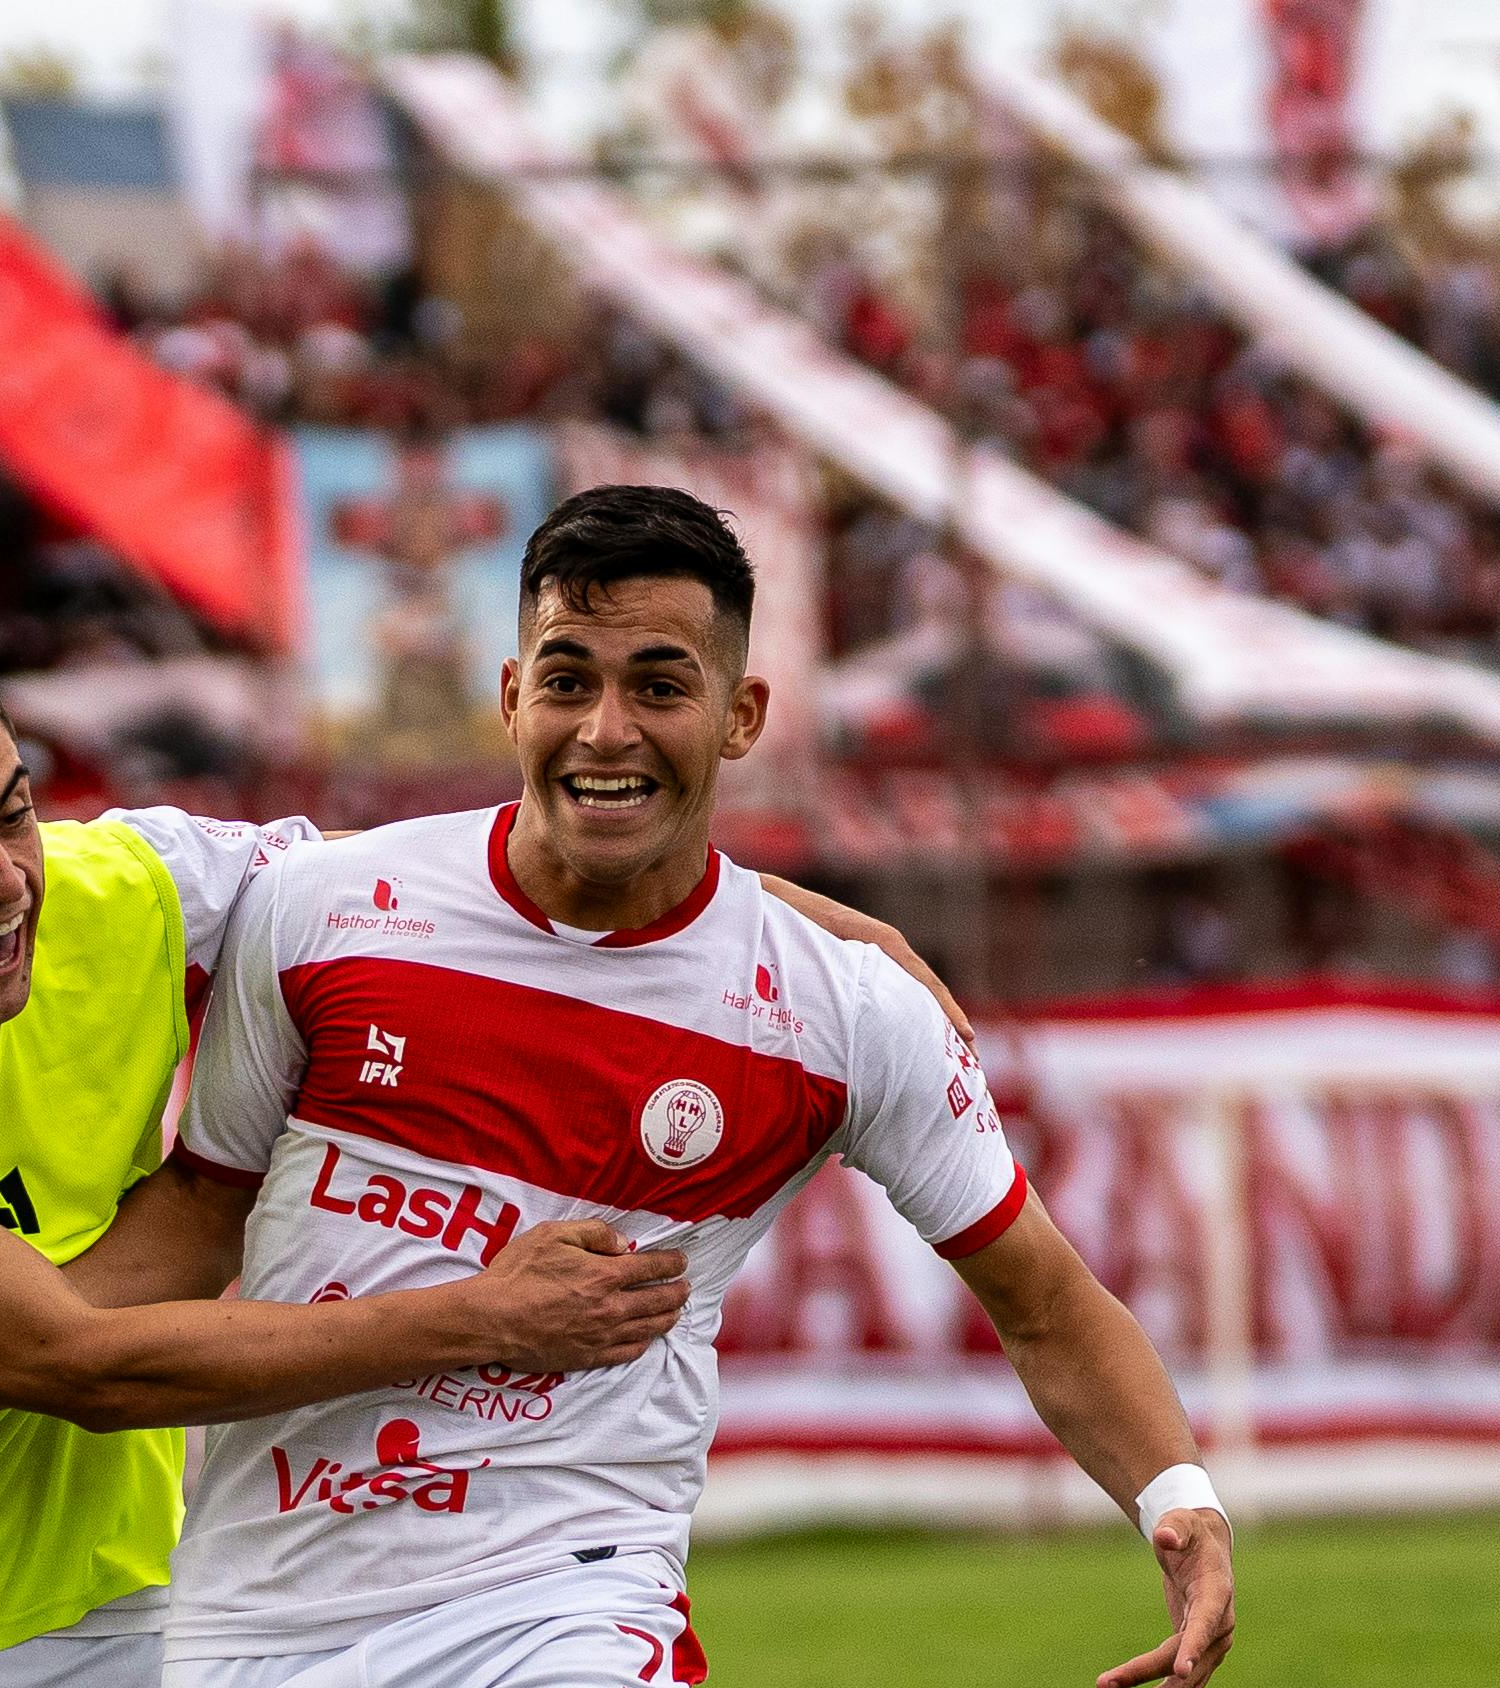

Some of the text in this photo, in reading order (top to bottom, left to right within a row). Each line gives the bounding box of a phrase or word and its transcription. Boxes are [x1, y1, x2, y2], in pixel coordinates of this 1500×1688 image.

[327, 912, 436, 934] Hathor Hotels
[359, 1060, 404, 1087] IFK
[310, 1141, 522, 1269] LasH
[271, 1445, 471, 1514] Vitsa
[613, 1622, 664, 1683] 7
